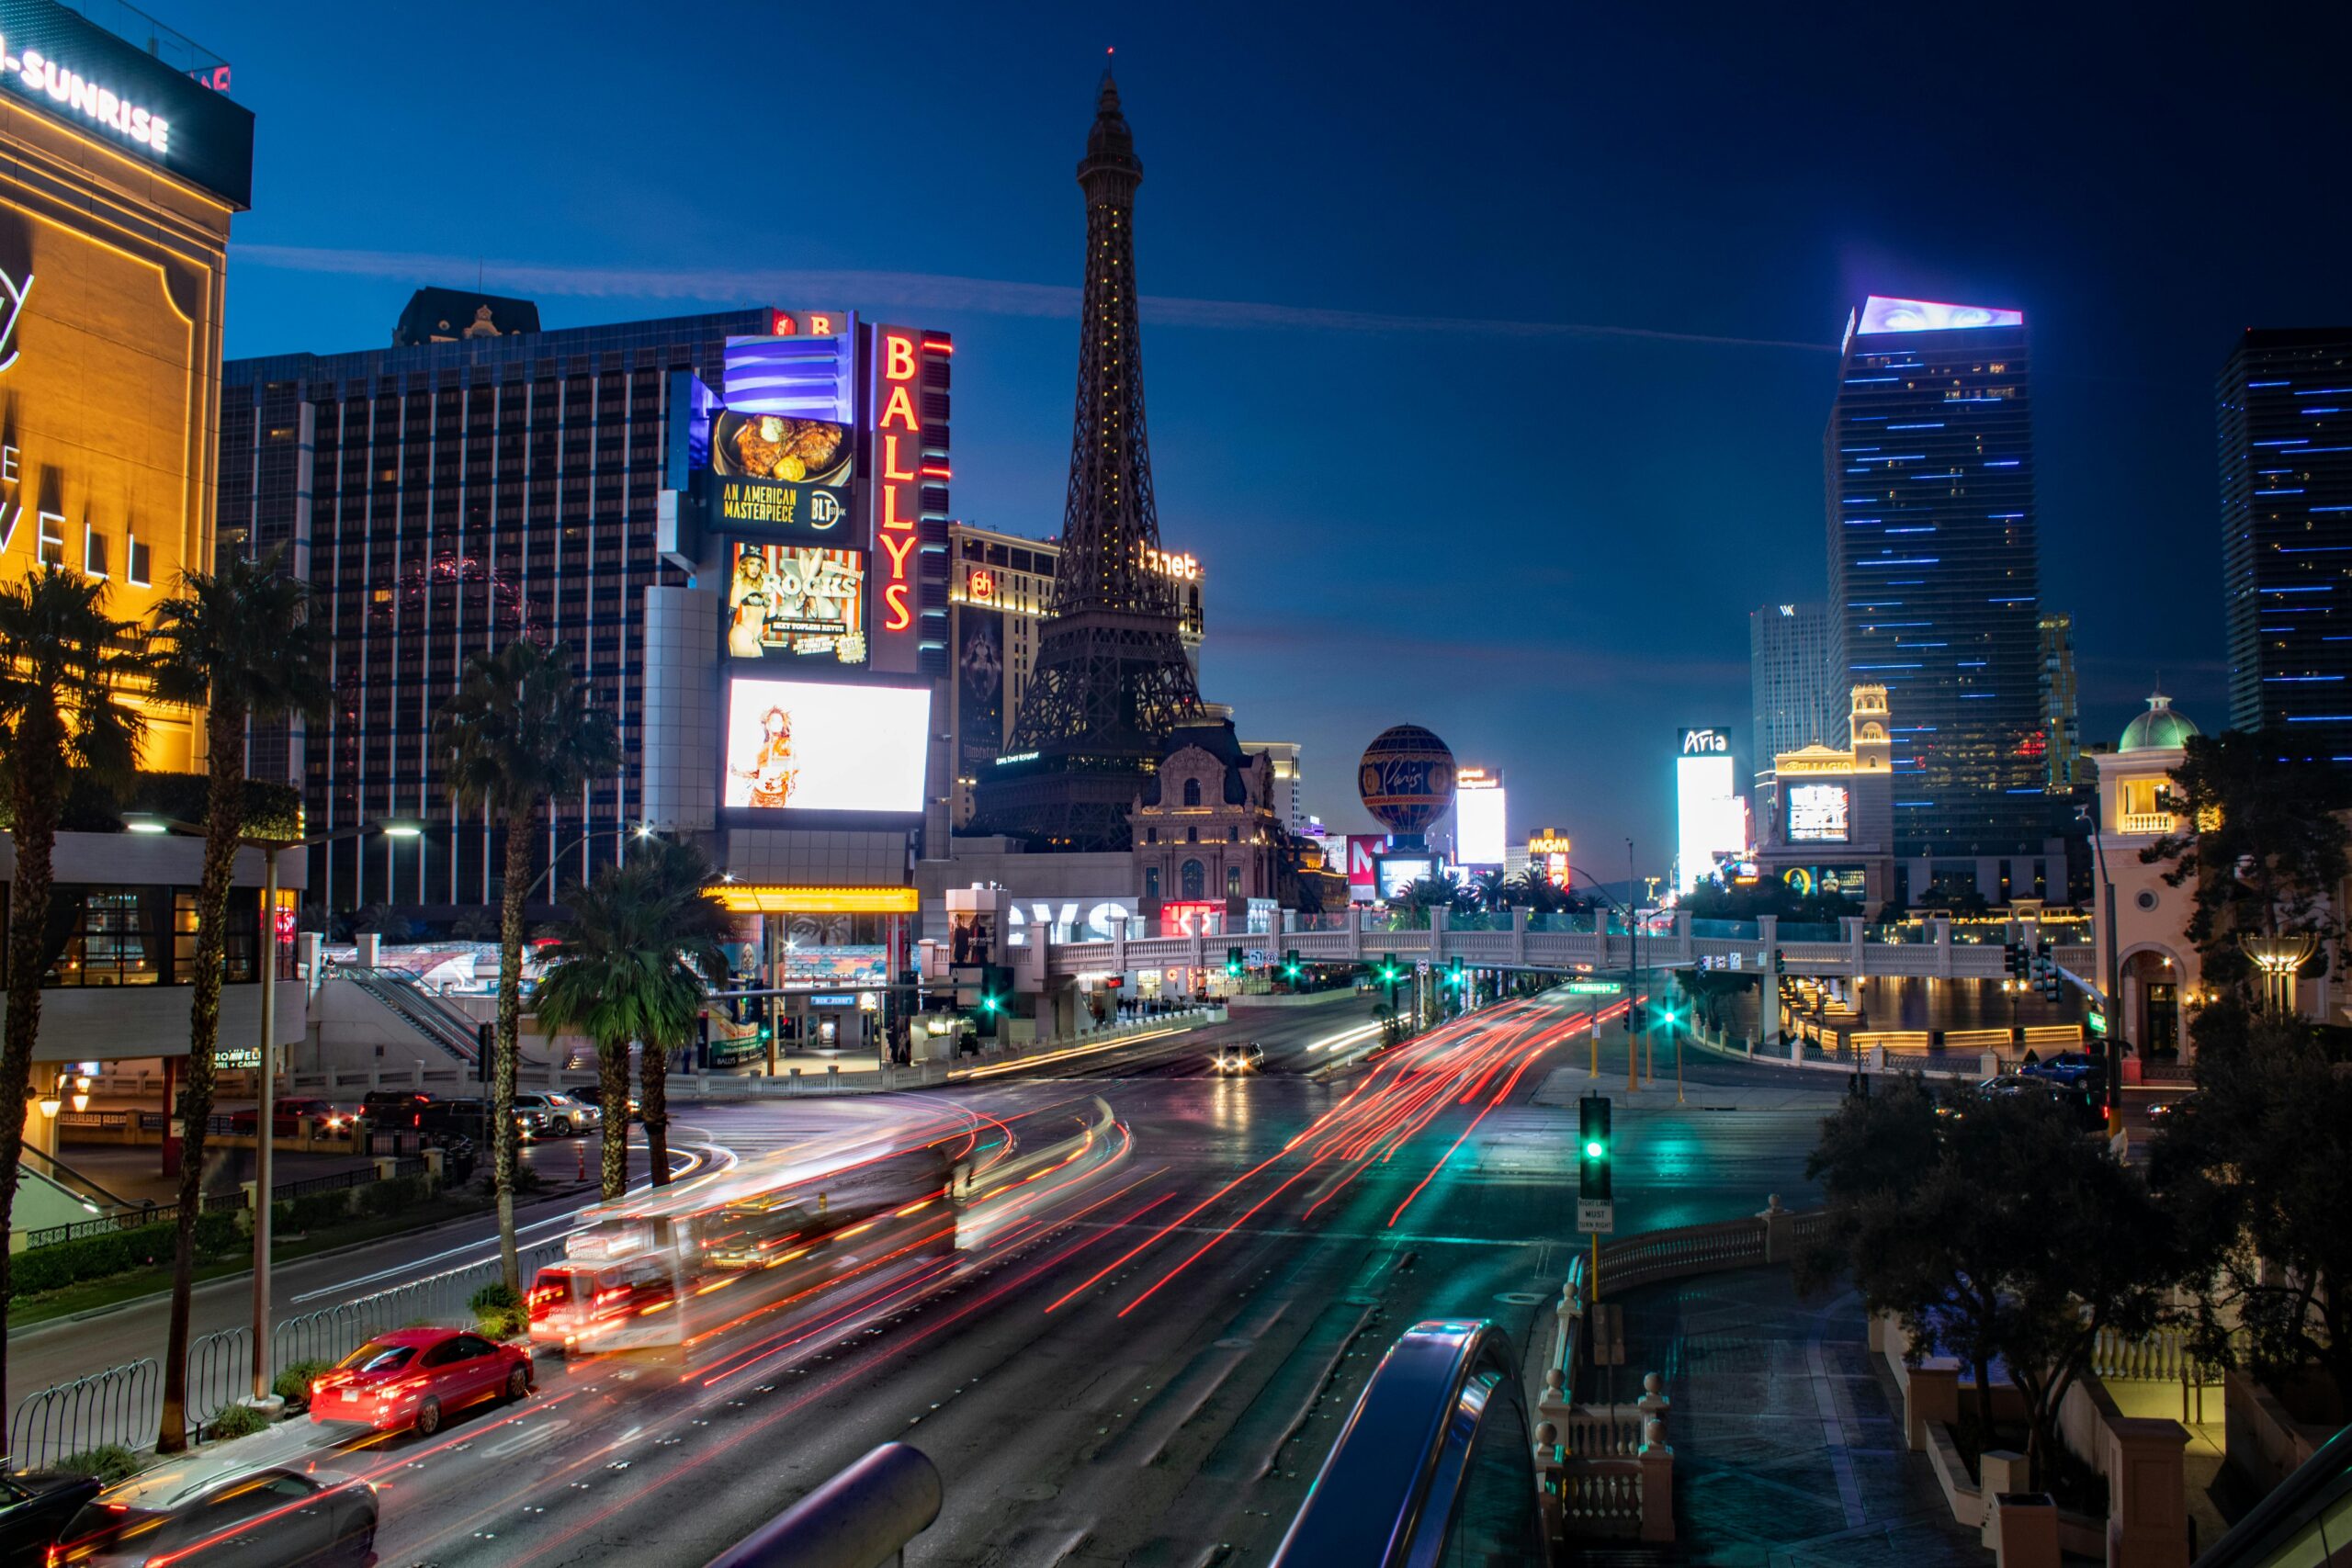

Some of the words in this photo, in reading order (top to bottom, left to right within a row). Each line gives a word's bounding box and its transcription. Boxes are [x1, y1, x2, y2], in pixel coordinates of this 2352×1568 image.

[0, 35, 169, 152] -SUNRISE
[879, 334, 920, 630] BALLYS
[723, 483, 739, 501] AN
[743, 485, 797, 506] AMERICAN
[724, 501, 794, 524] MASTERPIECE
[811, 498, 831, 521] BLT
[1128, 539, 1196, 580] lanet
[1683, 730, 1726, 754] Aria
[1383, 754, 1423, 800] Paris
[1785, 761, 1851, 772] BELLAGIO
[1529, 839, 1569, 852] MGM
[1585, 1210, 1604, 1219] MUST
